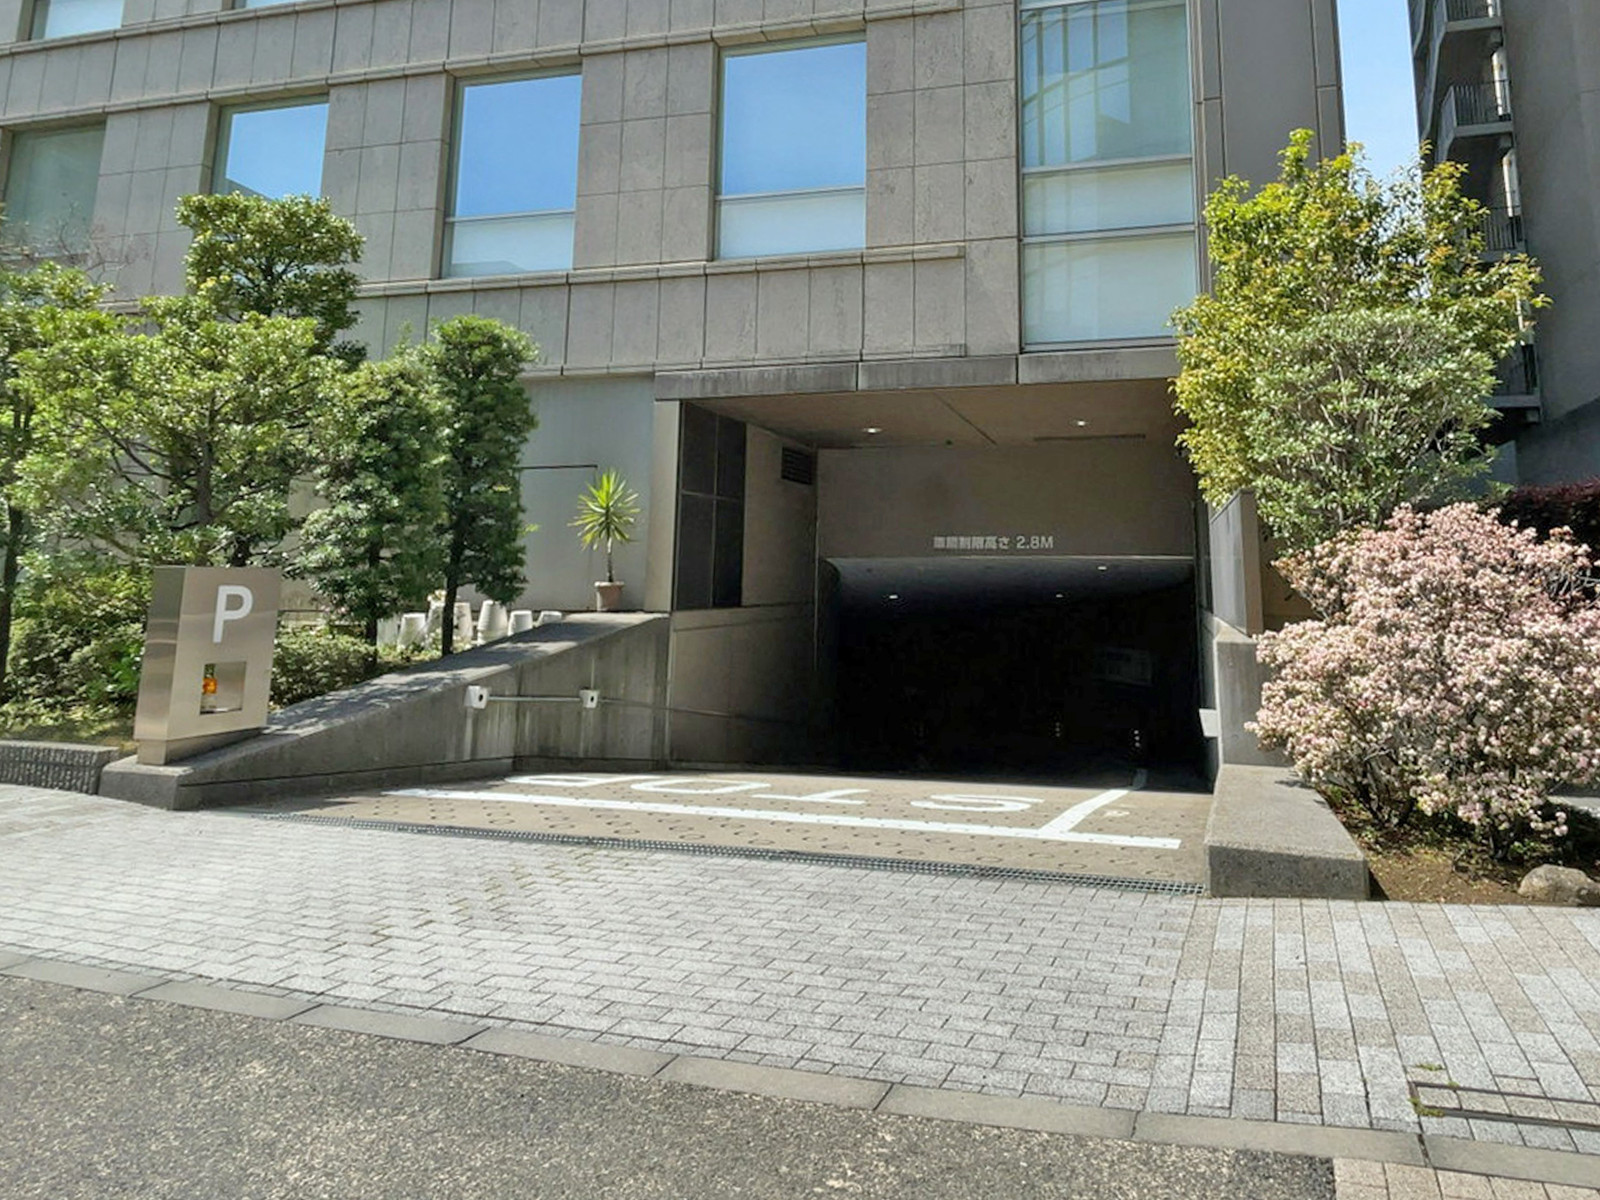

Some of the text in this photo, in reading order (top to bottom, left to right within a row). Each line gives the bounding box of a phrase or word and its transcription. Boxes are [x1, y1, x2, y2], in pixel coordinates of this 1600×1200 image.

[1017, 535, 1053, 549] 2.8M
[213, 585, 253, 643] P
[505, 775, 1043, 811] STOP
